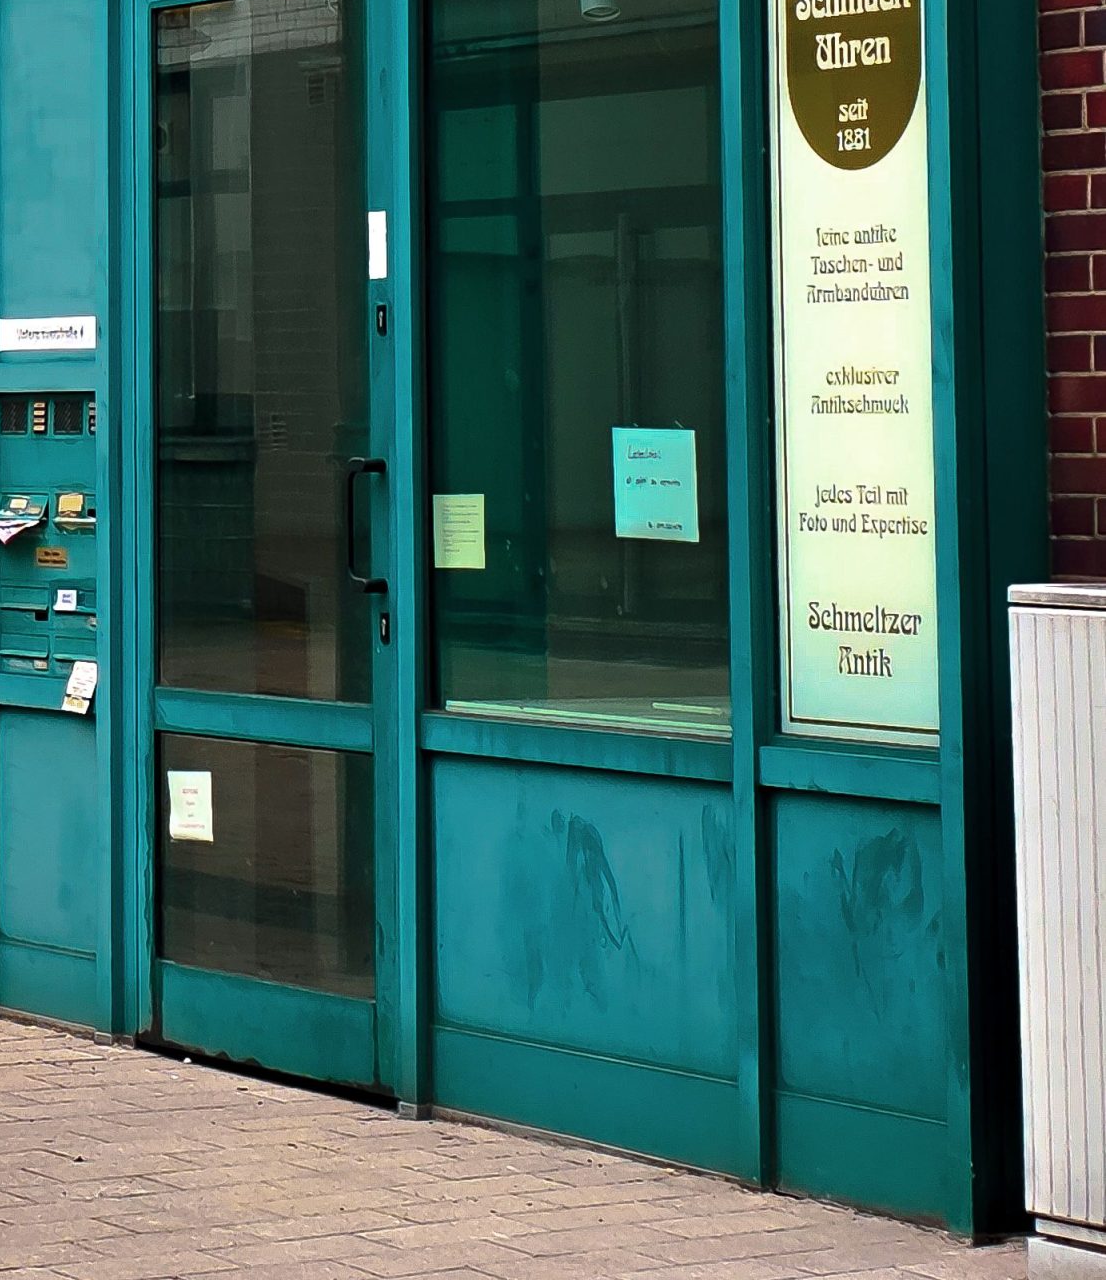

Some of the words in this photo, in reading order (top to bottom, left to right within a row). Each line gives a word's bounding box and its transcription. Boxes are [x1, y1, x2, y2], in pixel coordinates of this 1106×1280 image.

[816, 32, 891, 70] Uhren
[838, 97, 869, 122] seit
[836, 127, 871, 152] 1881
[854, 224, 897, 245] antike
[811, 255, 874, 276] Taschen-
[878, 251, 903, 272] und
[806, 281, 909, 304] Armbanduhren
[826, 366, 900, 386] exklusiver
[811, 395, 909, 415] Antikschmuck
[856, 484, 881, 505] Teil
[886, 487, 909, 506] mit
[799, 512, 828, 532] Foto
[832, 513, 856, 534] und
[861, 514, 928, 539] Expertise
[808, 601, 922, 636] Schmeltzer
[838, 645, 893, 678] Antik
